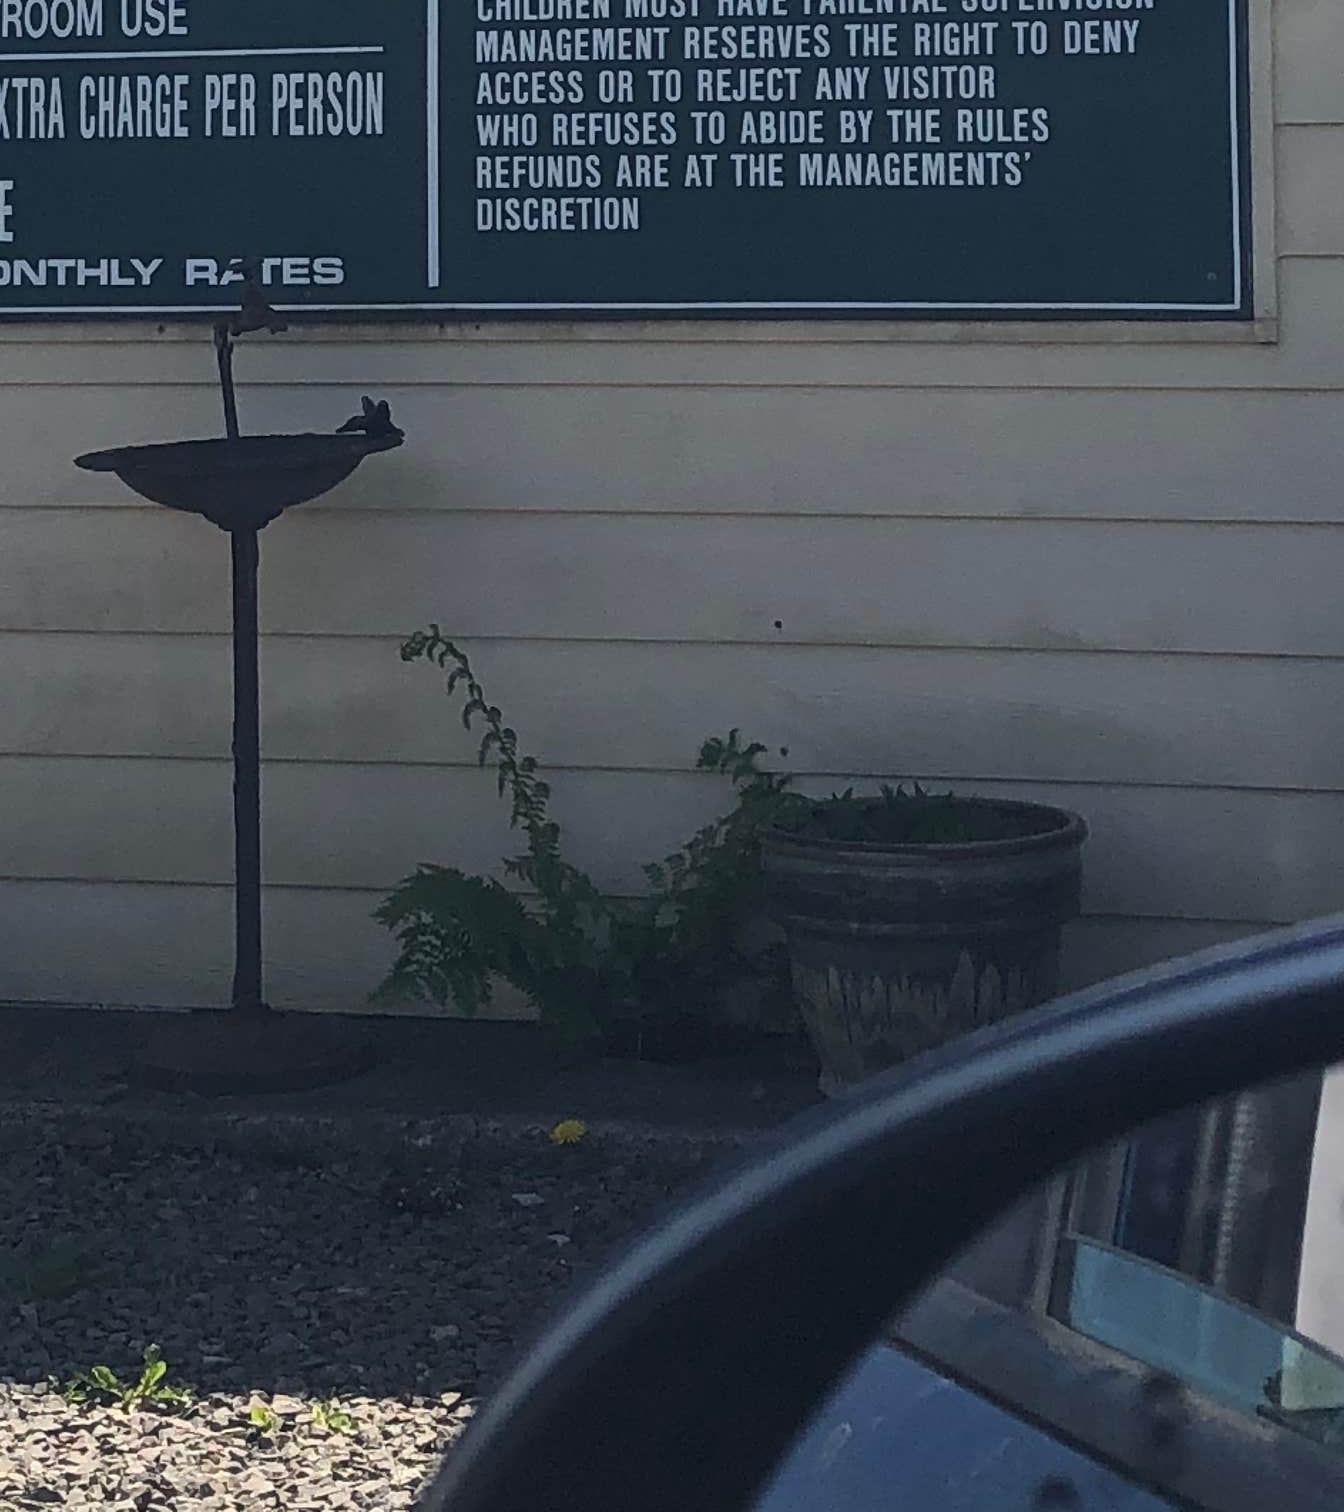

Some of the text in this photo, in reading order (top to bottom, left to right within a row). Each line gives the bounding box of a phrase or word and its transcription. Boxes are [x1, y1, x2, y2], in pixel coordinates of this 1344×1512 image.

[477, 20, 1139, 62] MANAGEMENT RESERVES THE RIGHT TO DENY
[477, 65, 994, 104] ACCESS OR TO REJECT ANY VISITOR
[80, 75, 188, 138] CHARGE
[206, 74, 255, 136] PER
[273, 71, 383, 135] PERSON
[477, 108, 1048, 146] WHO REFUSES TO ABIDE BY THE RULES
[477, 155, 600, 188] REFUNDS
[617, 155, 669, 187] ARE
[685, 155, 717, 186] AT
[731, 154, 783, 186] THE
[477, 198, 638, 230] DISCRETION
